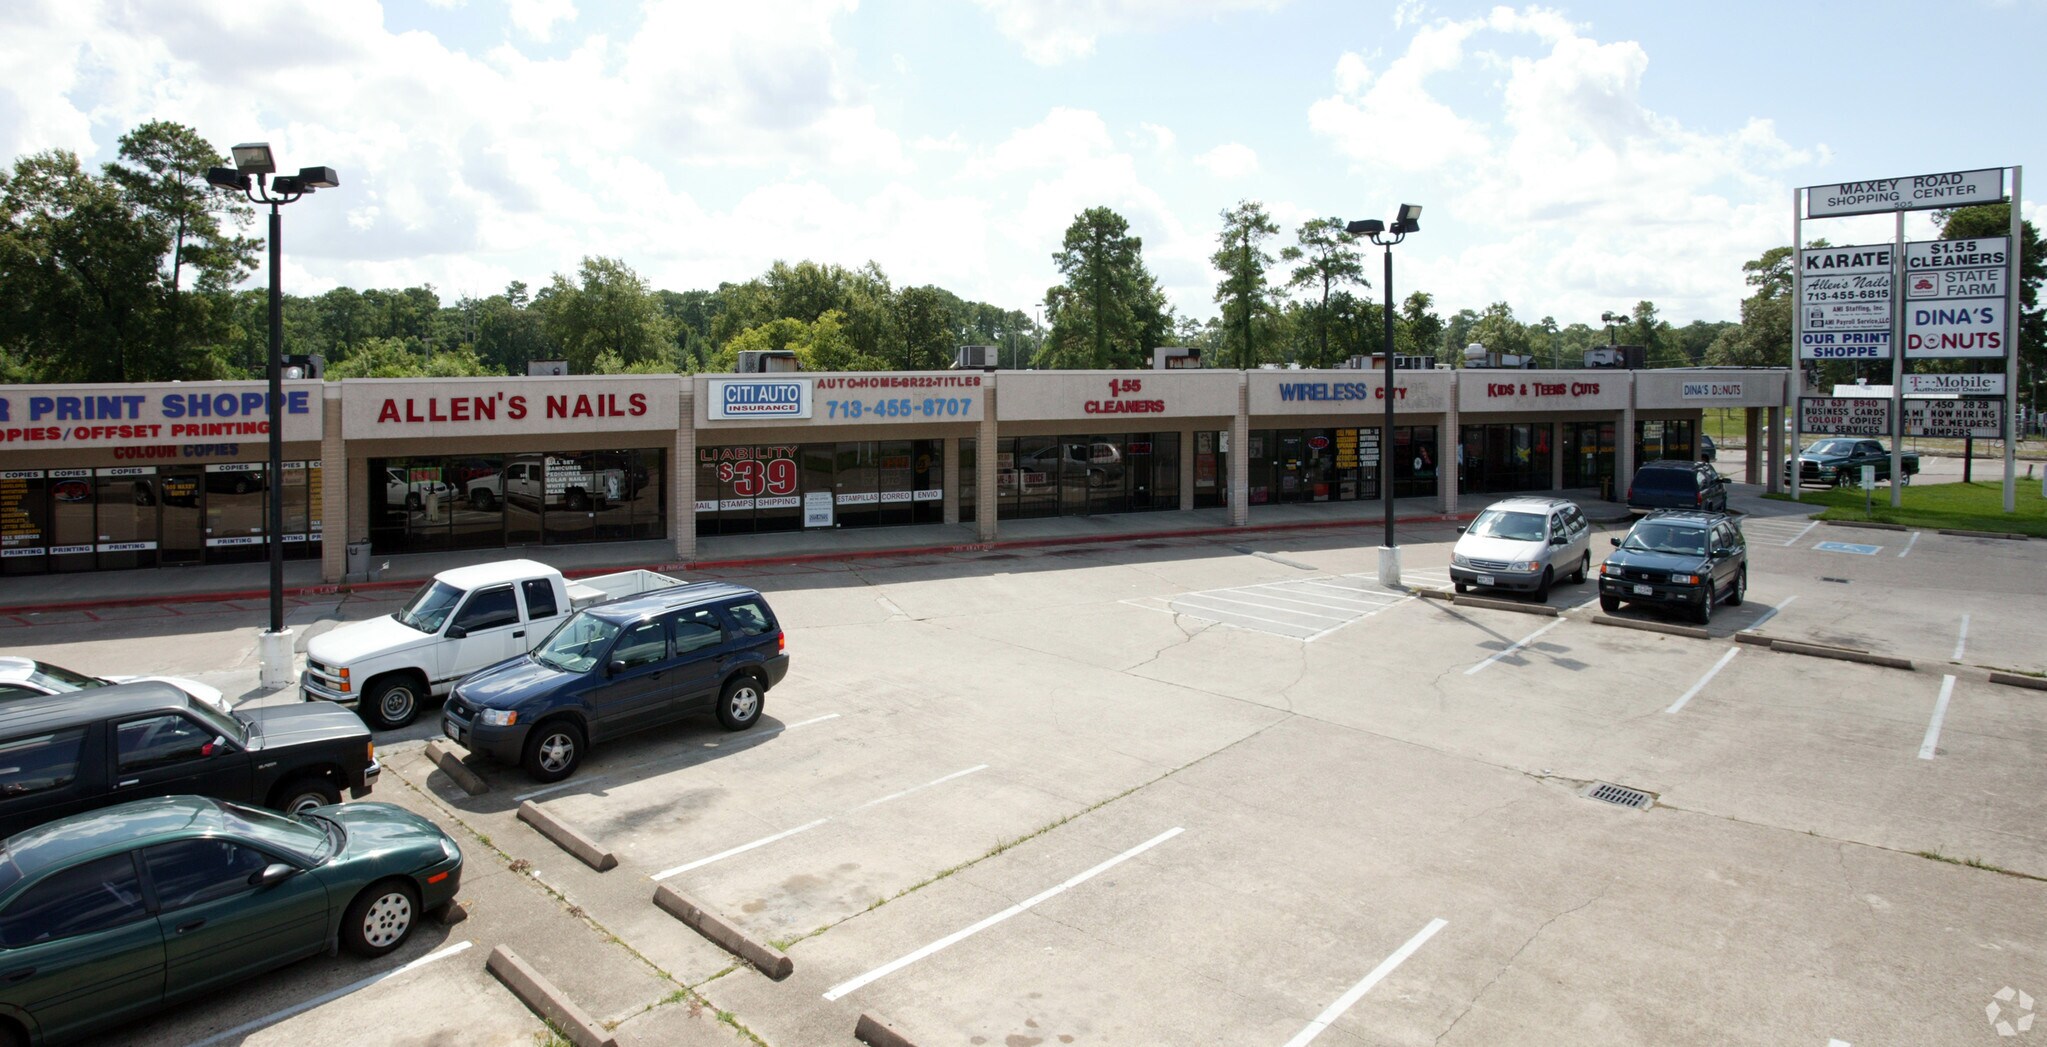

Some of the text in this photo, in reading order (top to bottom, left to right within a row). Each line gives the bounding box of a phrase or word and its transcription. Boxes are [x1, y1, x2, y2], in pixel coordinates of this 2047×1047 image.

[1840, 173, 1963, 195] MAXEY ROAD
[1827, 184, 1976, 207] SHOPPING CENTER
[1930, 241, 1977, 255] $1.55
[1807, 251, 1890, 270] KARATE
[1909, 252, 2005, 268] CLEANERS
[1945, 269, 1999, 283] STATE
[1806, 276, 1889, 292] Allen's Nails
[1947, 283, 1996, 296] FARM
[1807, 289, 1889, 301] 713-455-6815
[1916, 307, 1994, 326] DINA'S
[1803, 333, 1890, 344] OUR PRINT
[1814, 346, 1878, 357] SHOPPE
[726, 385, 799, 403] CITI AUTO
[1109, 379, 1141, 397] 1.55
[1279, 383, 1367, 401] WIRELESS
[1520, 383, 1527, 396] &
[1684, 384, 1709, 396] DINA'S
[29, 396, 146, 421] PRINT
[377, 392, 647, 423] ALLEN'S NAILS
[728, 403, 797, 412] INSURANCE
[826, 397, 973, 419] 713-455-8707
[1084, 400, 1165, 414] CLEANERS
[1807, 416, 1882, 425] COLOUR COPIES
[171, 421, 271, 437] PRINTING
[1835, 425, 1879, 434] SERVICES
[1923, 428, 1972, 437] BUMPERS
[113, 443, 239, 460] COLOUR COPIES
[700, 446, 798, 462] LIABILITY
[5, 471, 39, 479] COPIES
[716, 458, 797, 497] $39
[720, 500, 754, 509] STAMPS
[758, 497, 797, 507] SHIPPING
[836, 490, 938, 503] ESTAMPILLAS CORREO ENVIO
